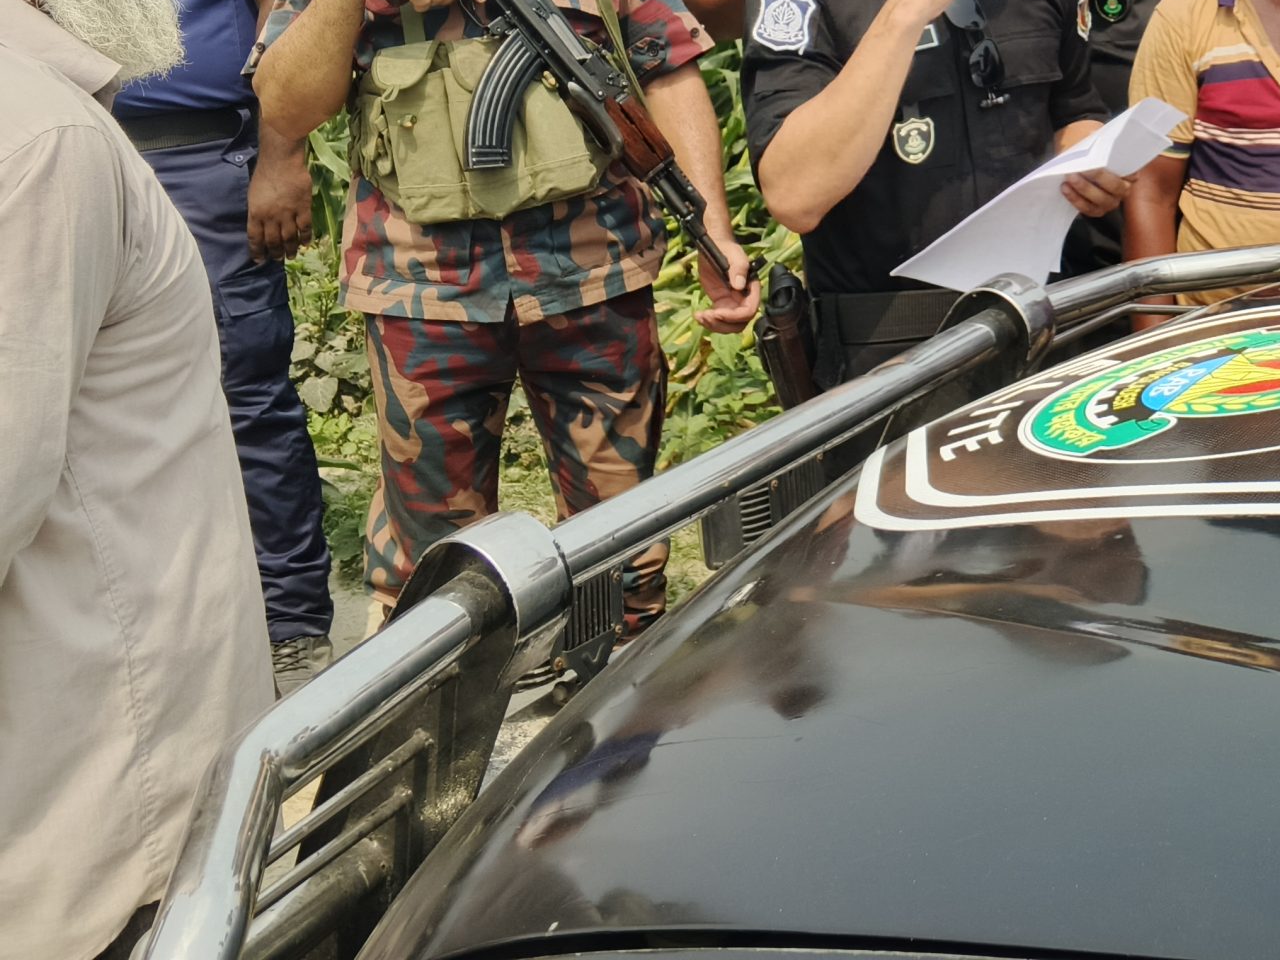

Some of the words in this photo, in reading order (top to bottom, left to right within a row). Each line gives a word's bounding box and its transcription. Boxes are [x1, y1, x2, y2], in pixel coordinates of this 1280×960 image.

[1112, 360, 1194, 411] BANGLADESH
[1148, 367, 1208, 397] RAB
[939, 358, 1122, 462] ELITE
